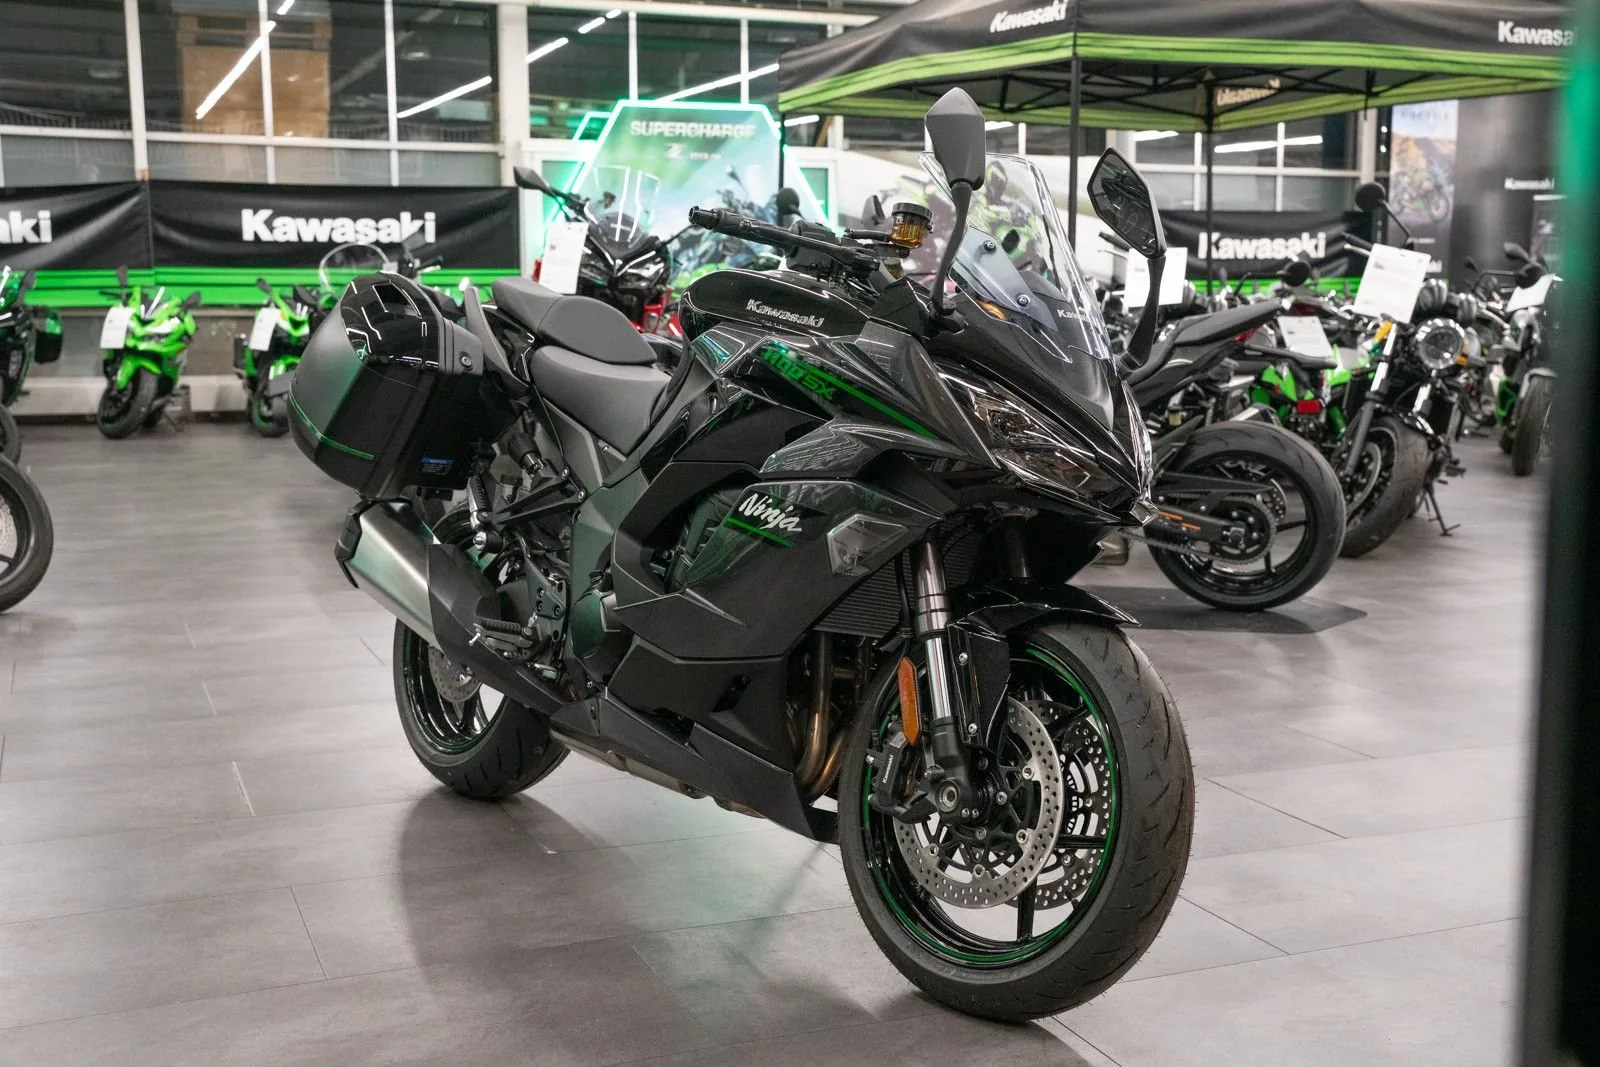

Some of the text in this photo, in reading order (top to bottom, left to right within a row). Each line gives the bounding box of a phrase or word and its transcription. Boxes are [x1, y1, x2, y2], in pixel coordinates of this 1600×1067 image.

[990, 0, 1068, 33] Kawasaki
[1497, 20, 1577, 47] Kawasa
[241, 208, 436, 243] Kawasaki
[1198, 232, 1326, 260] Kawasaki
[745, 298, 825, 328] Kawasaki
[738, 493, 802, 532] Ninja
